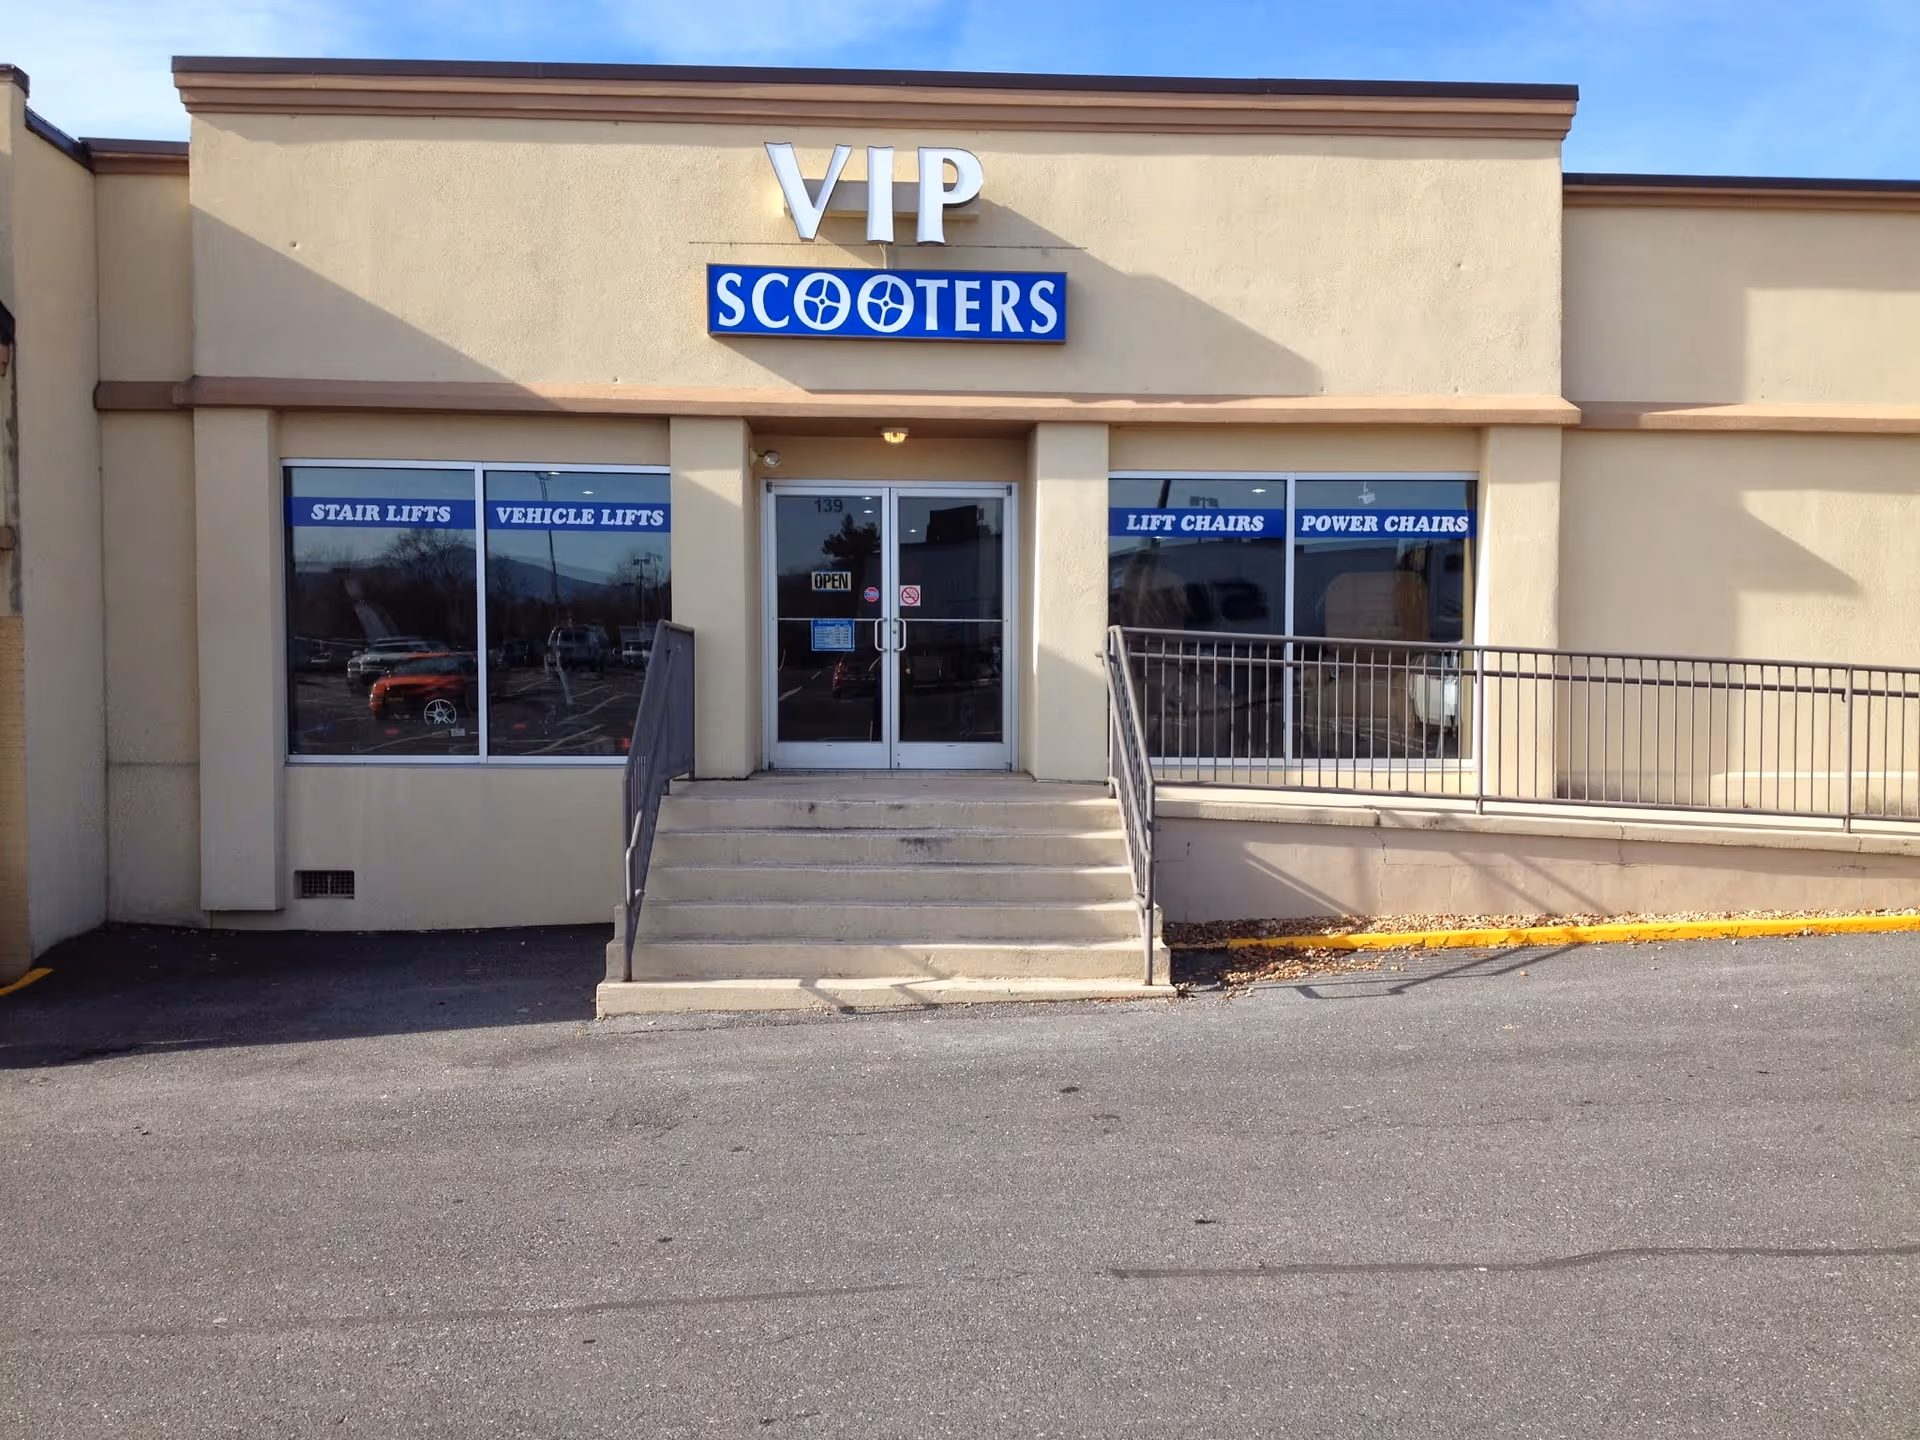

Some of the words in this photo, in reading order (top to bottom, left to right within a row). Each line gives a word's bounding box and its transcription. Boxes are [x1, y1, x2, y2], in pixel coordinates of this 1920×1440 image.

[764, 142, 984, 244] VIP
[716, 272, 1058, 333] SCOOTERS
[311, 504, 380, 522] STAIR
[386, 505, 451, 523] LIFTS
[813, 497, 843, 513] 139
[496, 507, 594, 525] VEHICLE
[600, 509, 664, 526] LIFTS
[1126, 514, 1175, 531] LIFT
[1181, 514, 1264, 532] CHAIRS
[1301, 515, 1378, 532] POWER
[1384, 516, 1468, 533] CHAIRS
[814, 573, 848, 589] OPEN
